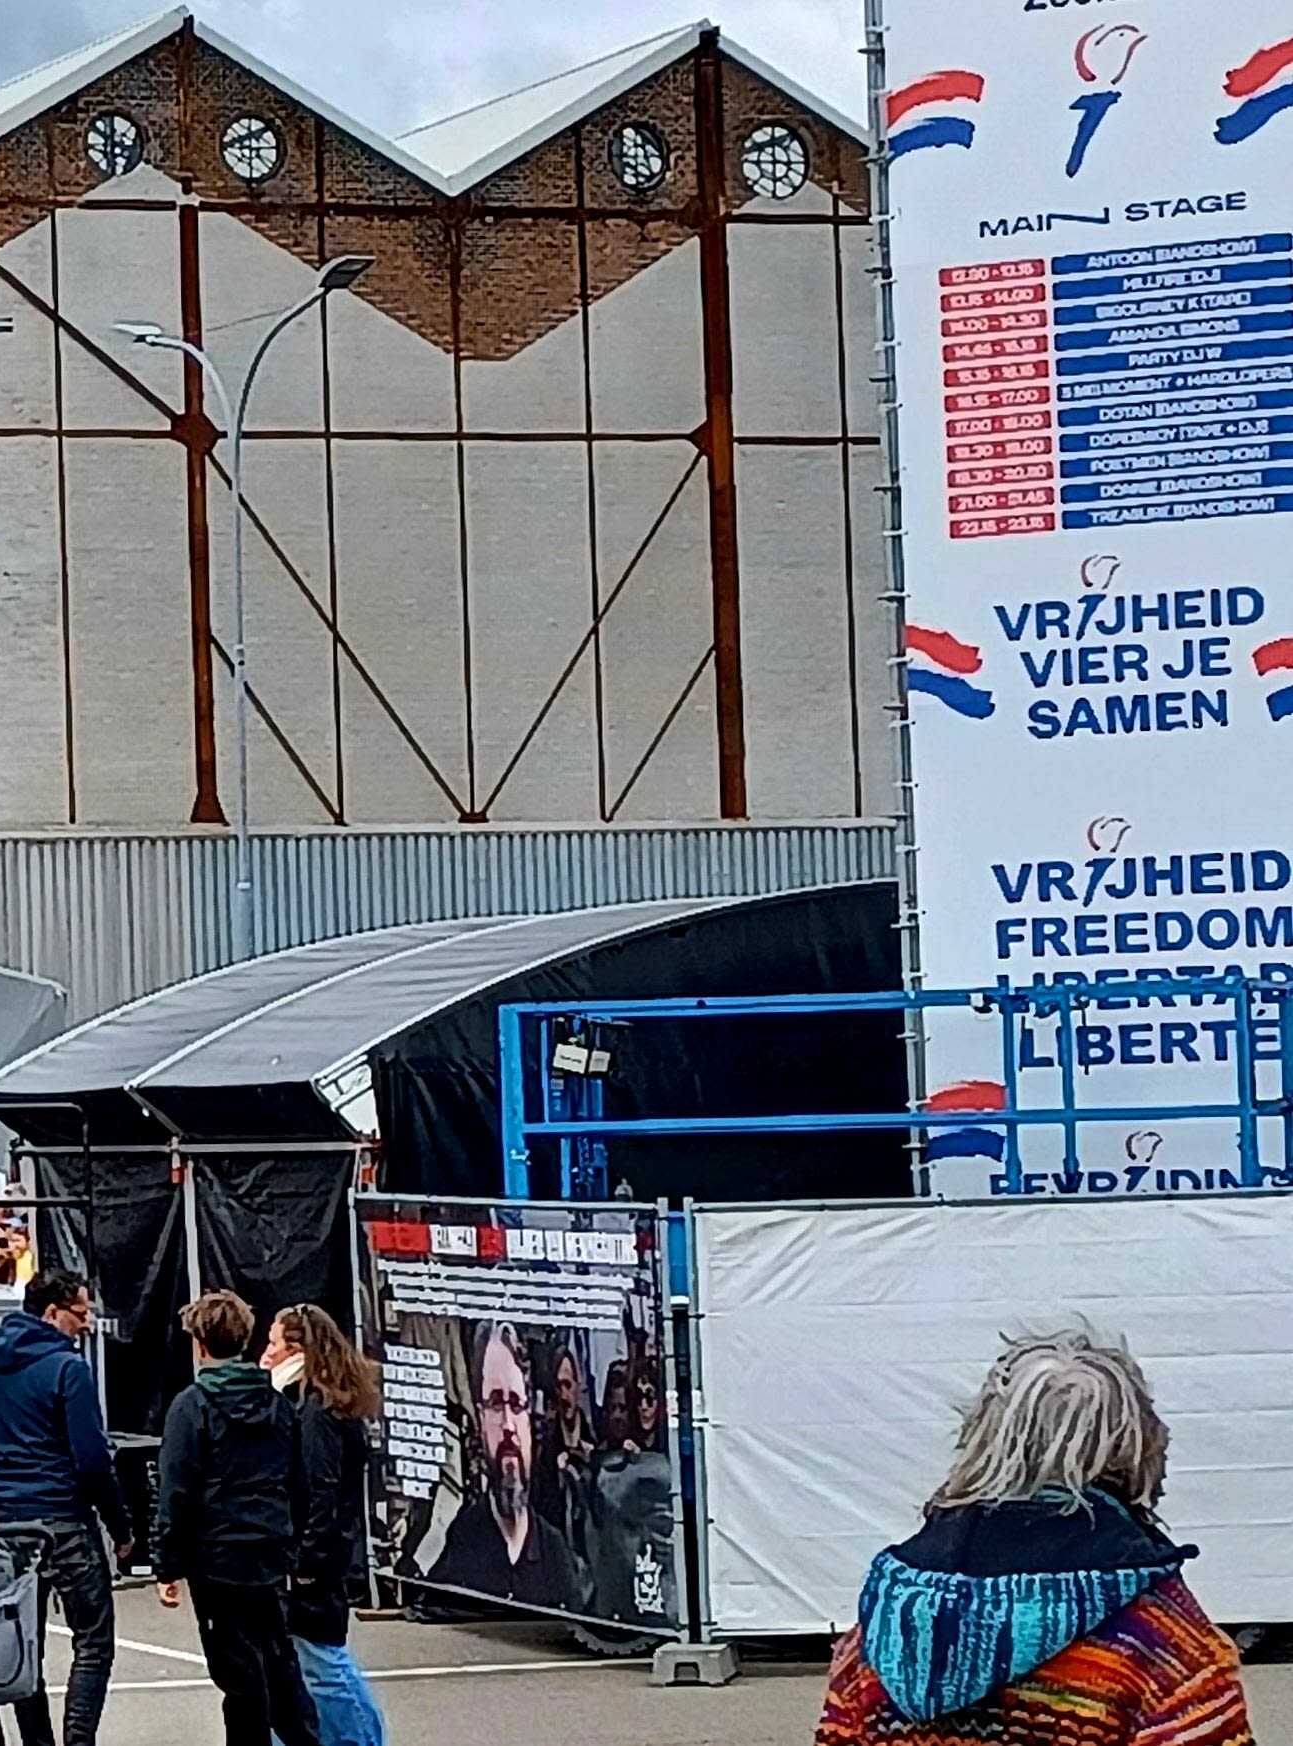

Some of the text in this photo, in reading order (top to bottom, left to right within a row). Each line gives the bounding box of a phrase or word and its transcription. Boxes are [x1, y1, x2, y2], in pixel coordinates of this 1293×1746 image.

[979, 191, 1247, 238] MAIN STAGE
[993, 586, 1264, 641] VRIJHEID
[1020, 637, 1232, 688] VIER JE
[1027, 689, 1229, 740] SAMEN
[990, 849, 1292, 907] VRIJHEID
[995, 906, 1293, 959] FREEDOM
